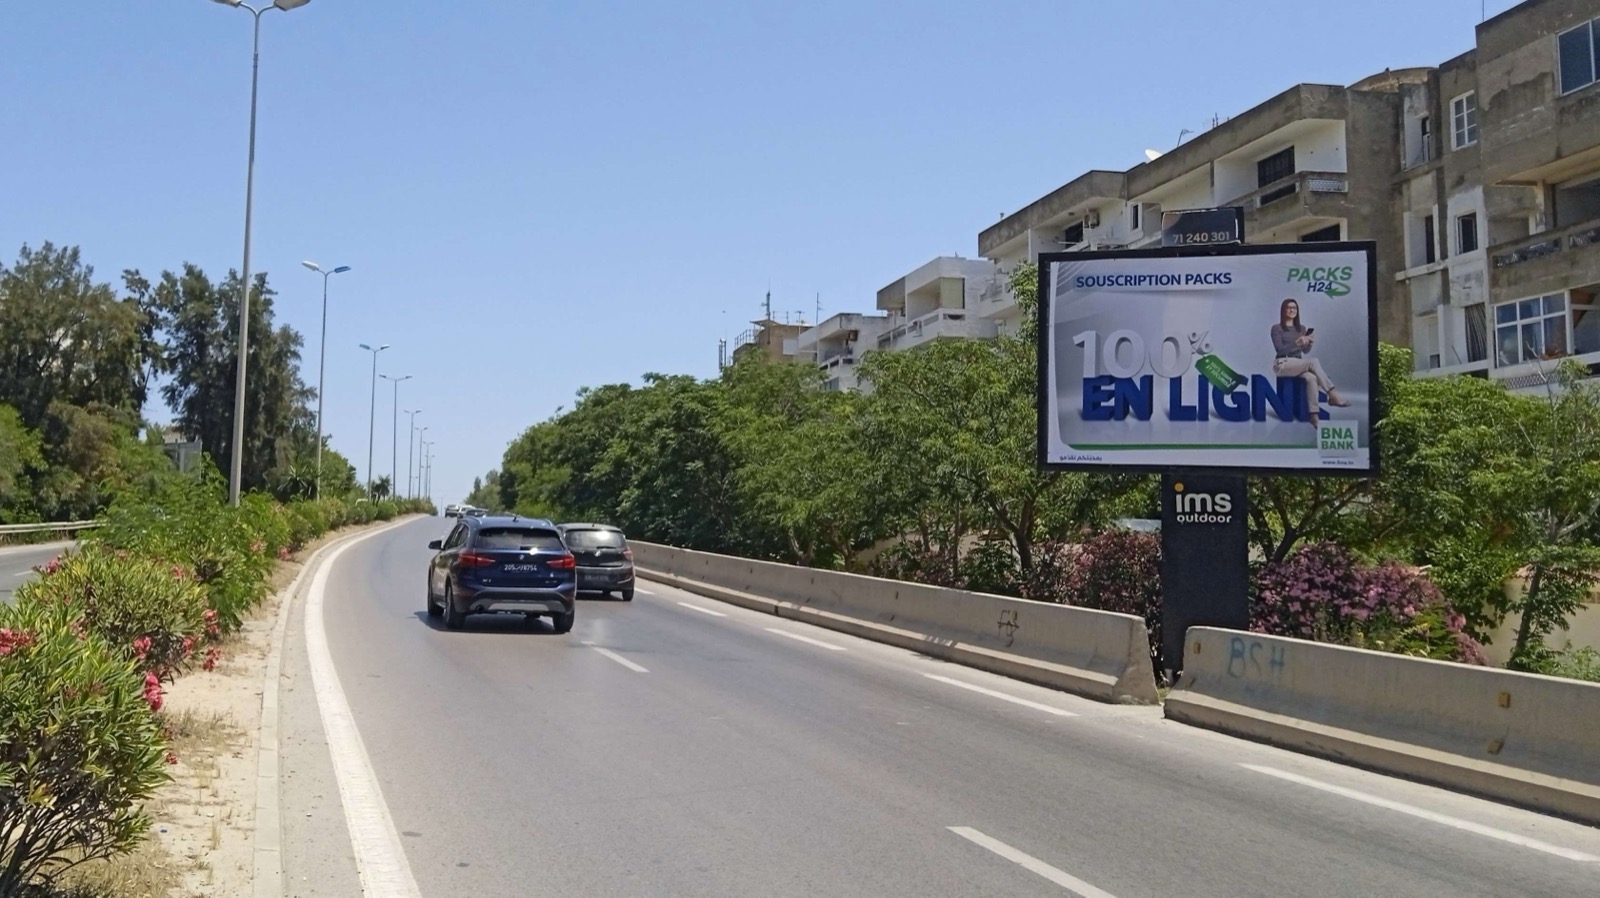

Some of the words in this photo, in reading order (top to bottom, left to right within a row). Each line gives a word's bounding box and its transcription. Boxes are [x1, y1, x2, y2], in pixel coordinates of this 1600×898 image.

[1173, 234, 1183, 243] 71
[1186, 233, 1208, 243] 240
[1211, 231, 1230, 241] 301
[1076, 274, 1181, 288] SOUSCRIPTION
[1185, 272, 1232, 285] PACKS
[1287, 266, 1353, 282] PACKS
[1307, 281, 1333, 292] H24
[1072, 329, 1214, 379] 100%
[1080, 373, 1154, 422] EN
[1321, 427, 1354, 439] BNA
[1321, 440, 1354, 450] BANK
[1174, 482, 1232, 513] ims
[1176, 513, 1232, 523] outdoor
